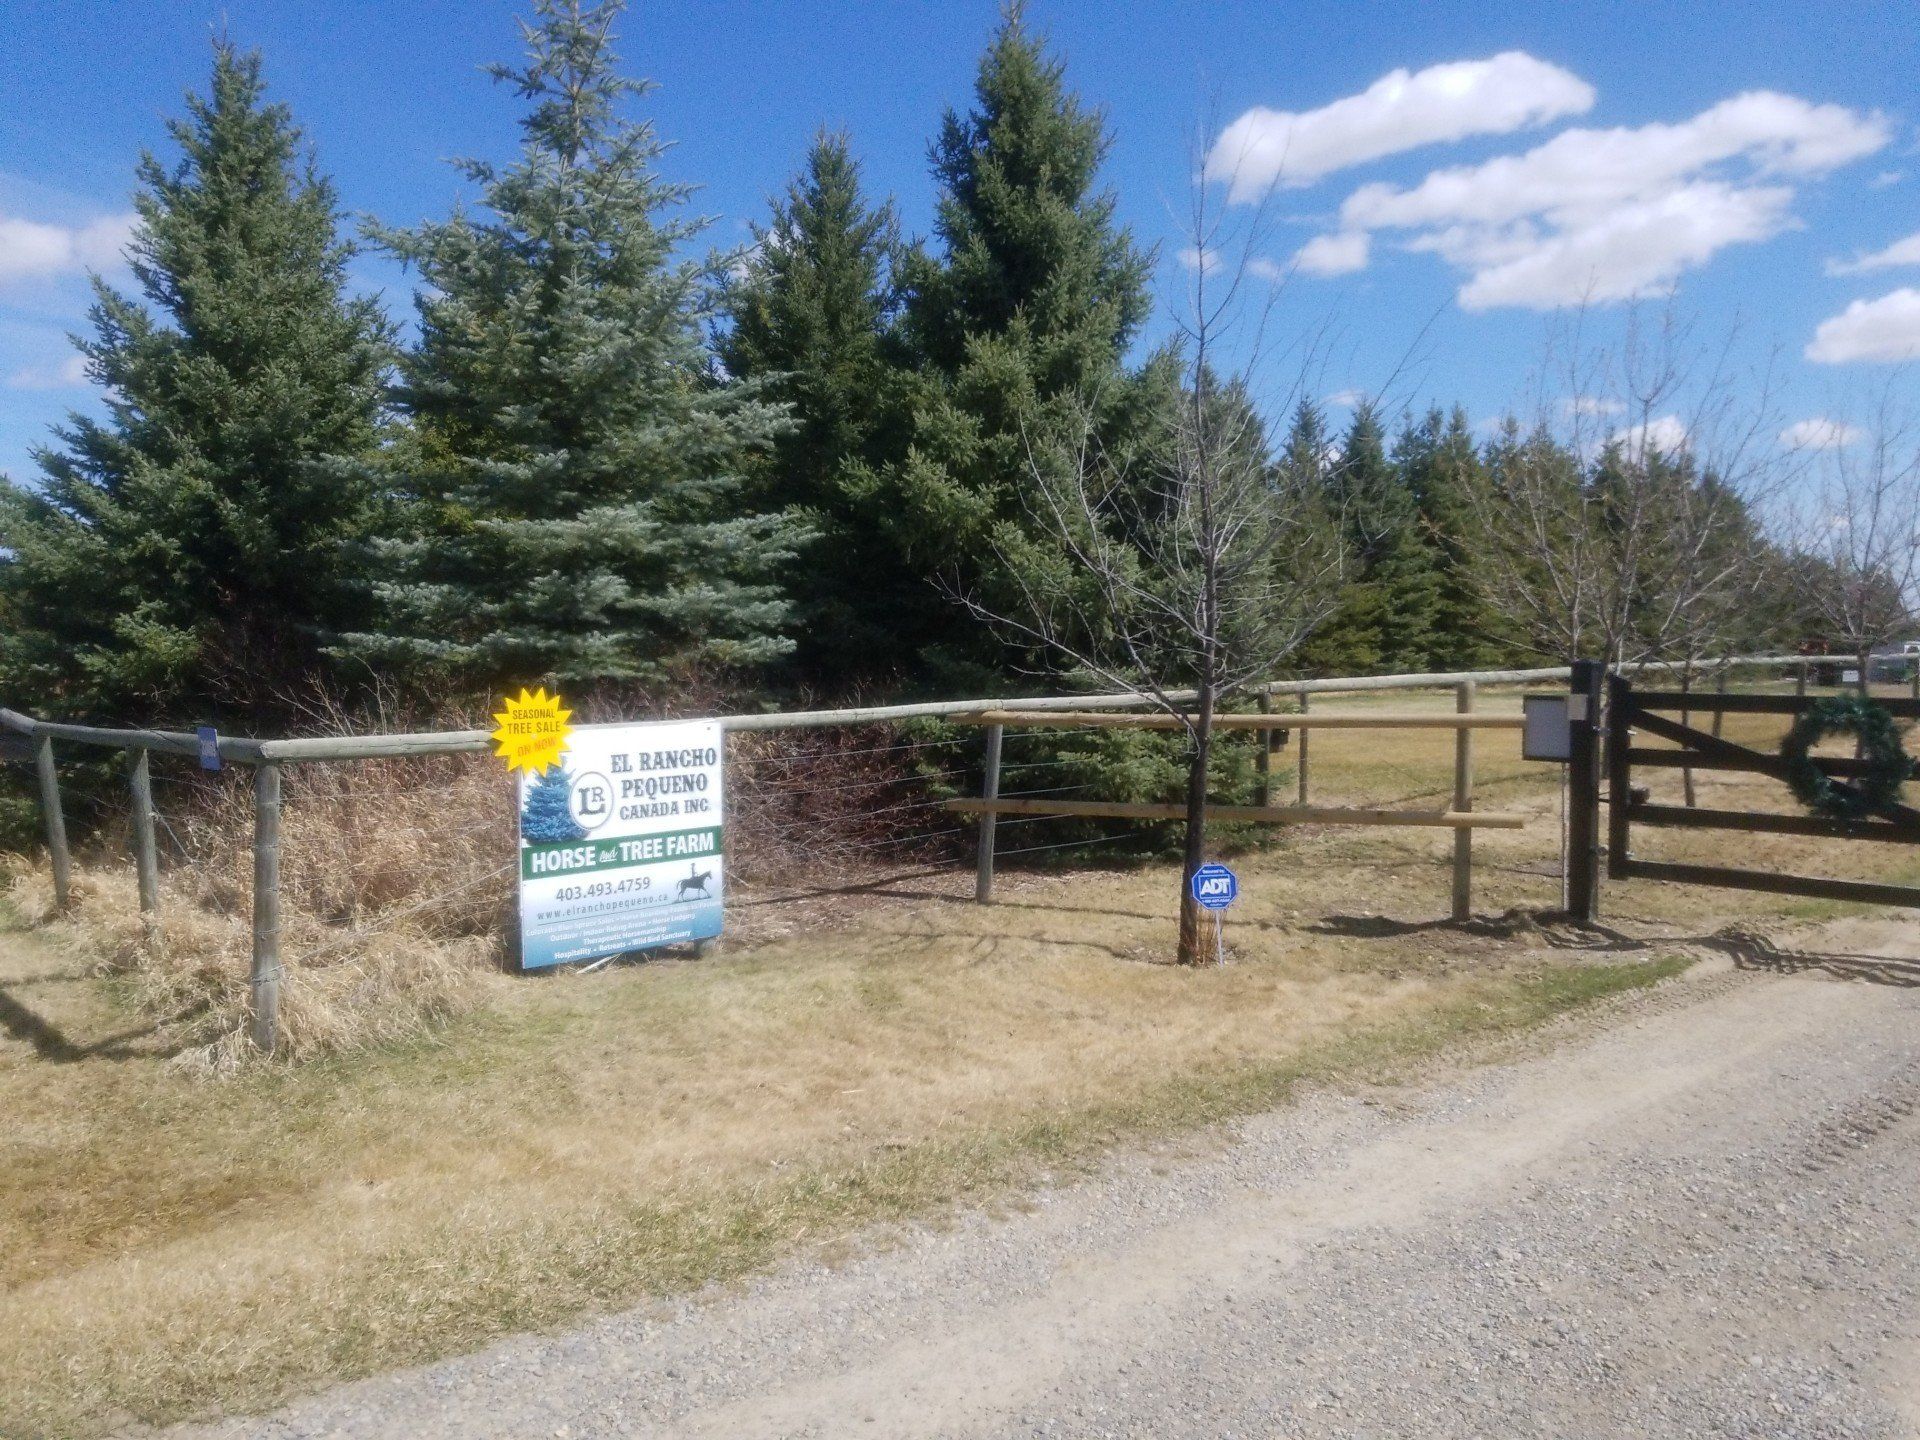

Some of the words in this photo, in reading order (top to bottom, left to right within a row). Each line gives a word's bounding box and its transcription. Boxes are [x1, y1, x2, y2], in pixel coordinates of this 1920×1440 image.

[512, 708, 556, 720] SEASONAL
[507, 722, 532, 734] TREE
[536, 721, 561, 733] SALE
[611, 753, 633, 773] EL
[639, 747, 717, 771] RANCHO
[621, 773, 708, 799] PEQUENO
[619, 801, 680, 820] CANADA
[532, 846, 597, 873] HORSE
[620, 838, 663, 862] TREE
[666, 832, 714, 856] FARM
[556, 876, 651, 902] 403.493.4759
[1200, 878, 1230, 895] ADT
